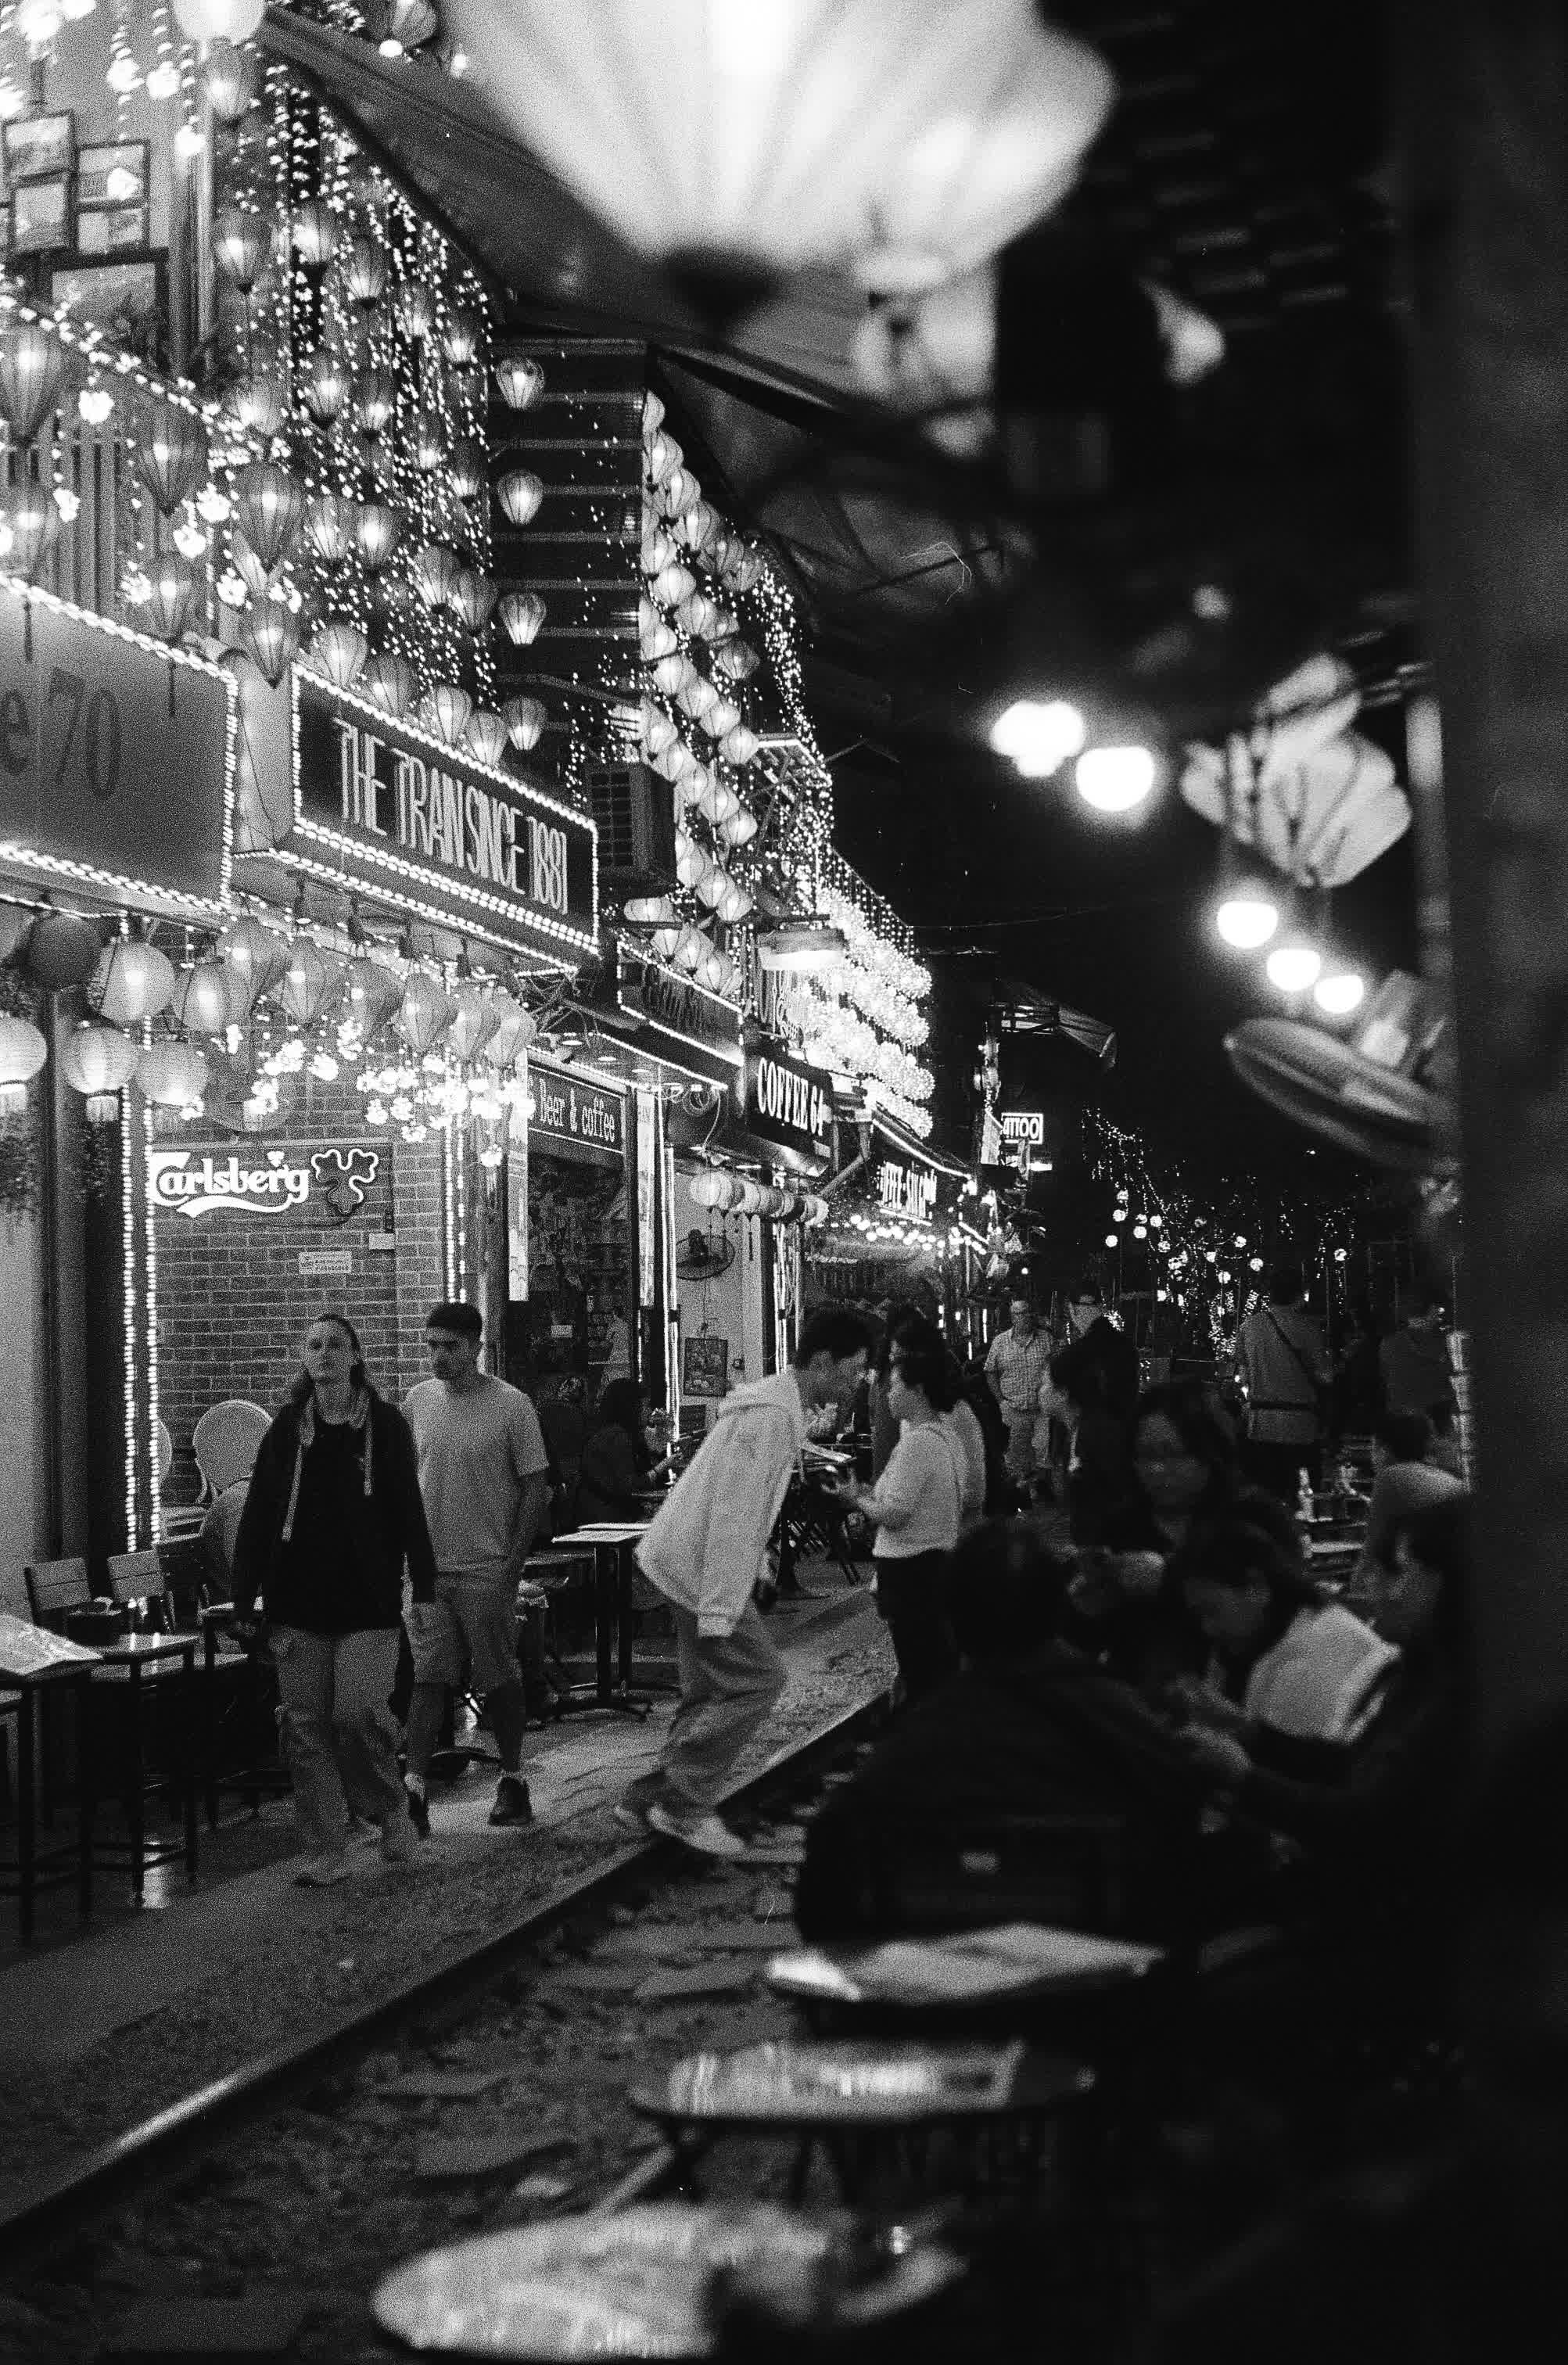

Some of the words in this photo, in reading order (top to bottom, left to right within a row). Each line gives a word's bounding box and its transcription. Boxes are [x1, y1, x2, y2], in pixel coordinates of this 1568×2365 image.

[48, 666, 122, 800] 70
[332, 717, 387, 837] THE
[465, 785, 525, 895] SINCE
[526, 816, 569, 915] 1881
[581, 1095, 615, 1143] coffee
[757, 1057, 809, 1131] COFFEE
[809, 1085, 824, 1137] 64
[1003, 1117, 1039, 1139] ATTOO
[149, 1152, 310, 1216] Carlsberg
